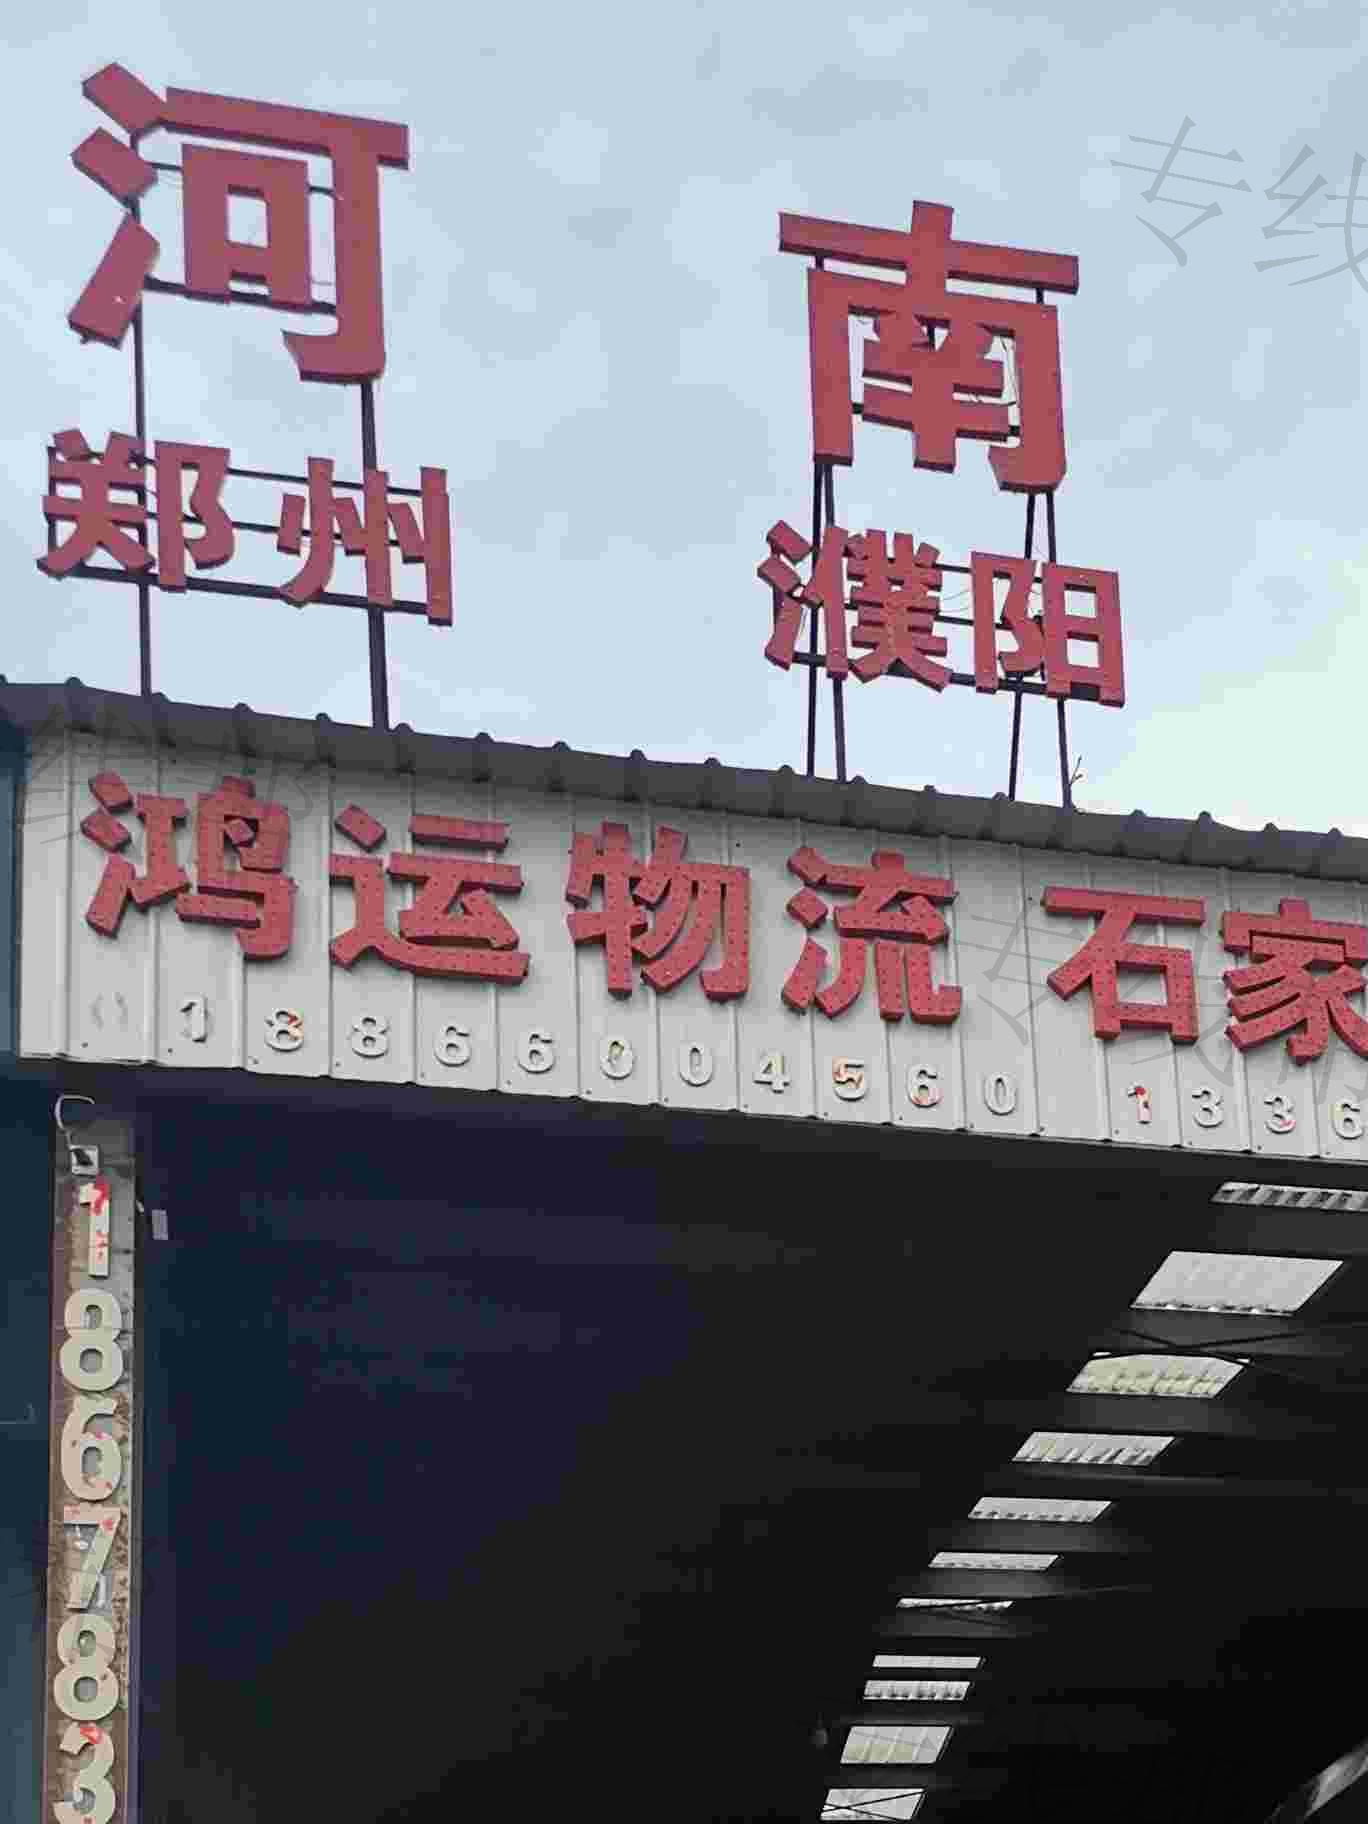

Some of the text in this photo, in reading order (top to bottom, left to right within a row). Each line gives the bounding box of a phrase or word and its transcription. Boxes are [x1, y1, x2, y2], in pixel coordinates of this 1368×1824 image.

[37, 428, 452, 625] 郑州
[757, 520, 1125, 708] 濮阳
[81, 771, 963, 1024] 鸿运物流
